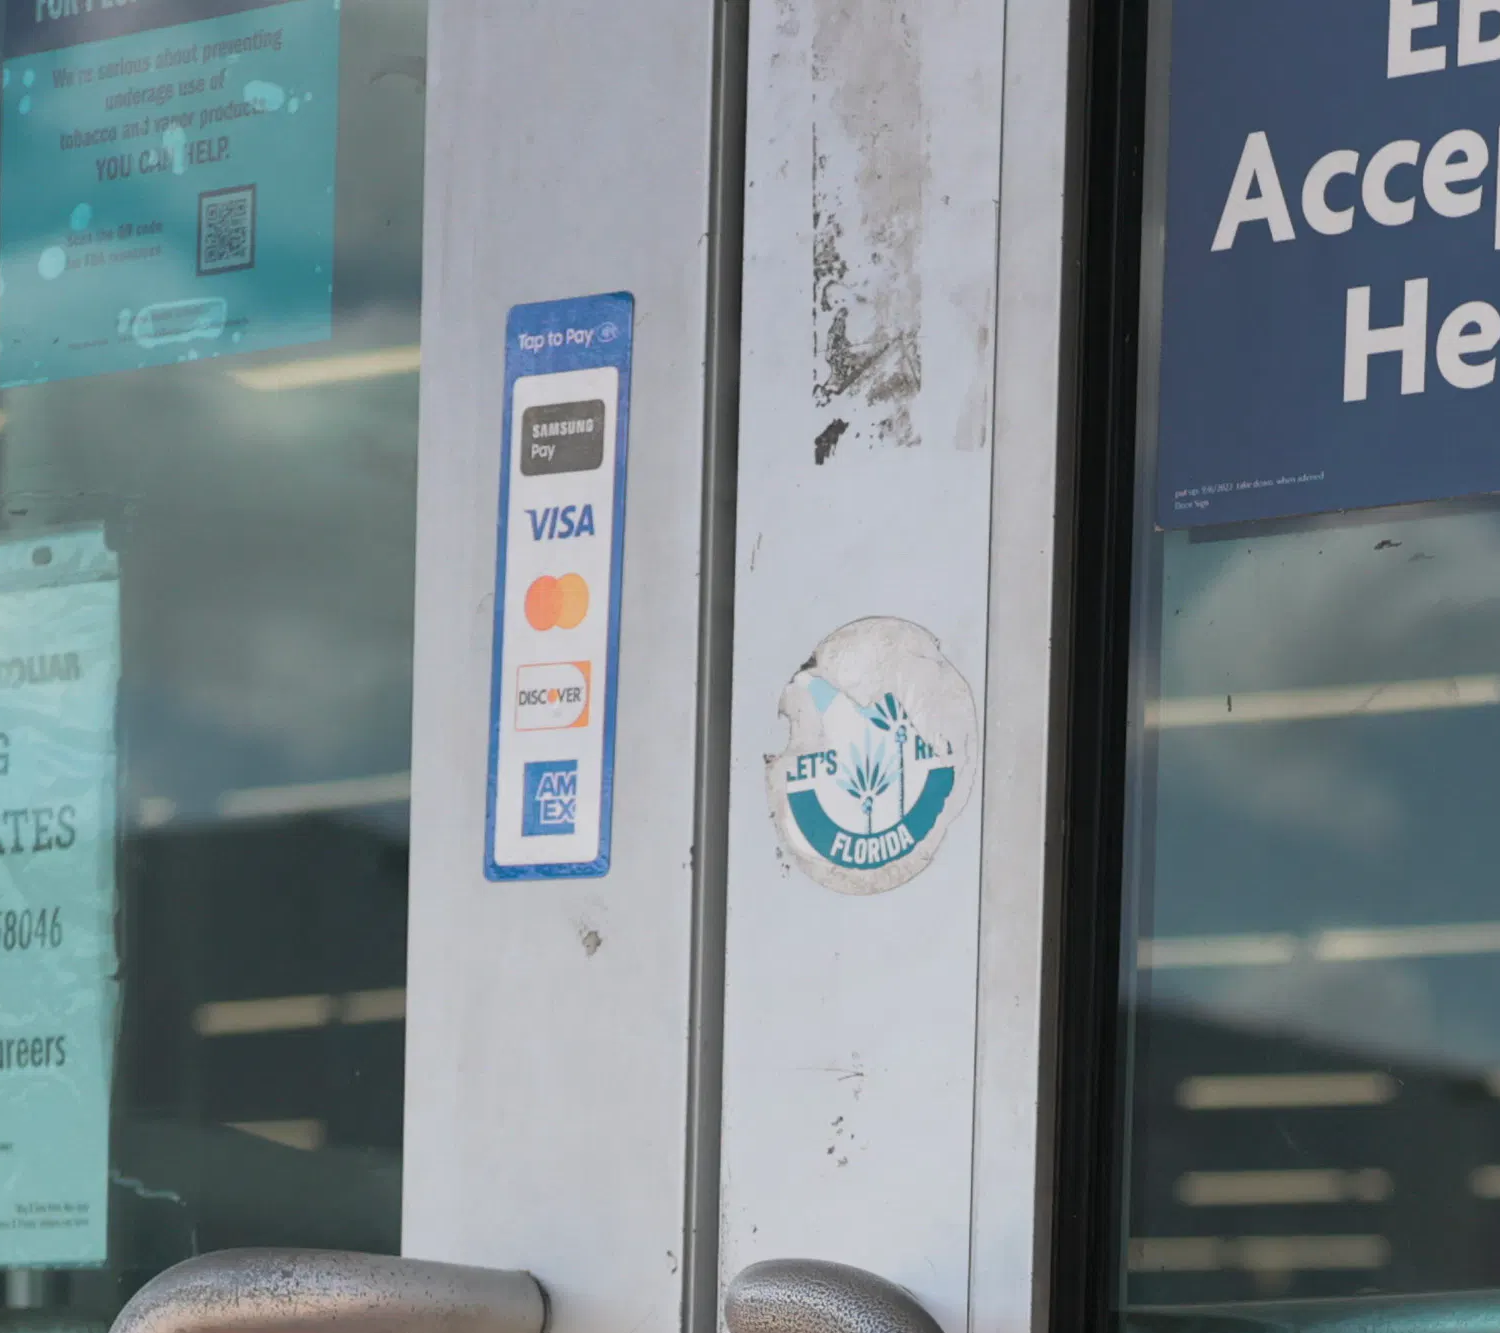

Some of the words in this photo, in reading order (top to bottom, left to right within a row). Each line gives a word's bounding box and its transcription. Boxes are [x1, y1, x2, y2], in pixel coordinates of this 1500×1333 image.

[155, 45, 199, 70] about
[202, 28, 284, 64] preventing
[105, 82, 175, 111] underage
[180, 78, 206, 95] use
[209, 69, 226, 90] of
[60, 123, 117, 151] tobacco
[96, 154, 132, 182] YOU
[518, 333, 544, 352] Tap
[548, 330, 562, 346] to
[567, 327, 594, 348] Pay
[532, 418, 594, 438] SAMSUNG
[531, 443, 555, 461] Pay
[524, 504, 594, 540] VISA
[518, 686, 582, 706] DISCOVER
[829, 823, 915, 865] FLORIDA
